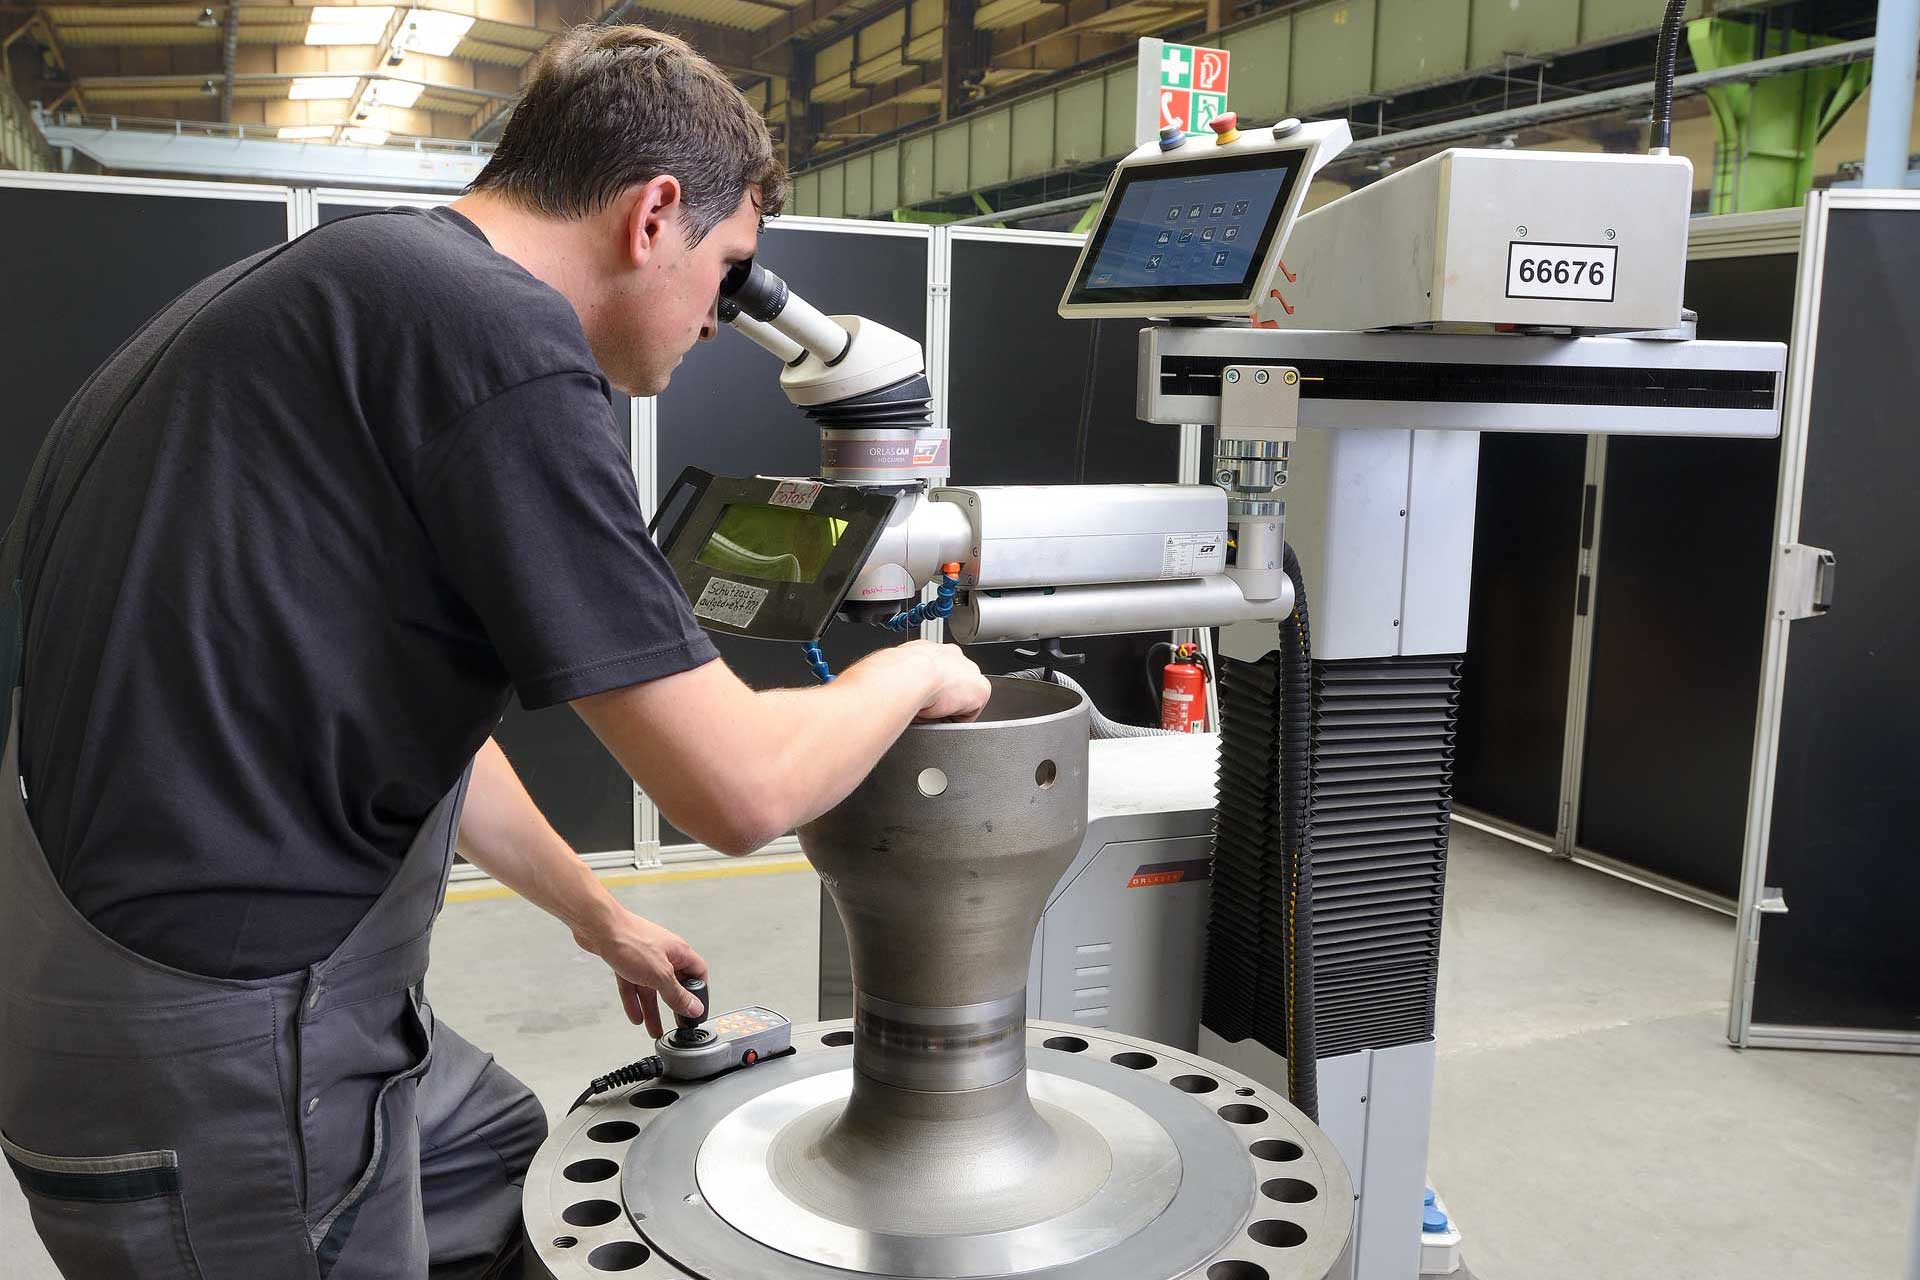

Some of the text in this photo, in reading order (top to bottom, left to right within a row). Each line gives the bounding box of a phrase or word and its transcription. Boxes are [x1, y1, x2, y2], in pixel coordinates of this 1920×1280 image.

[1518, 258, 1605, 286] 66676
[869, 447, 896, 456] ORLAS
[896, 447, 910, 456] CAM
